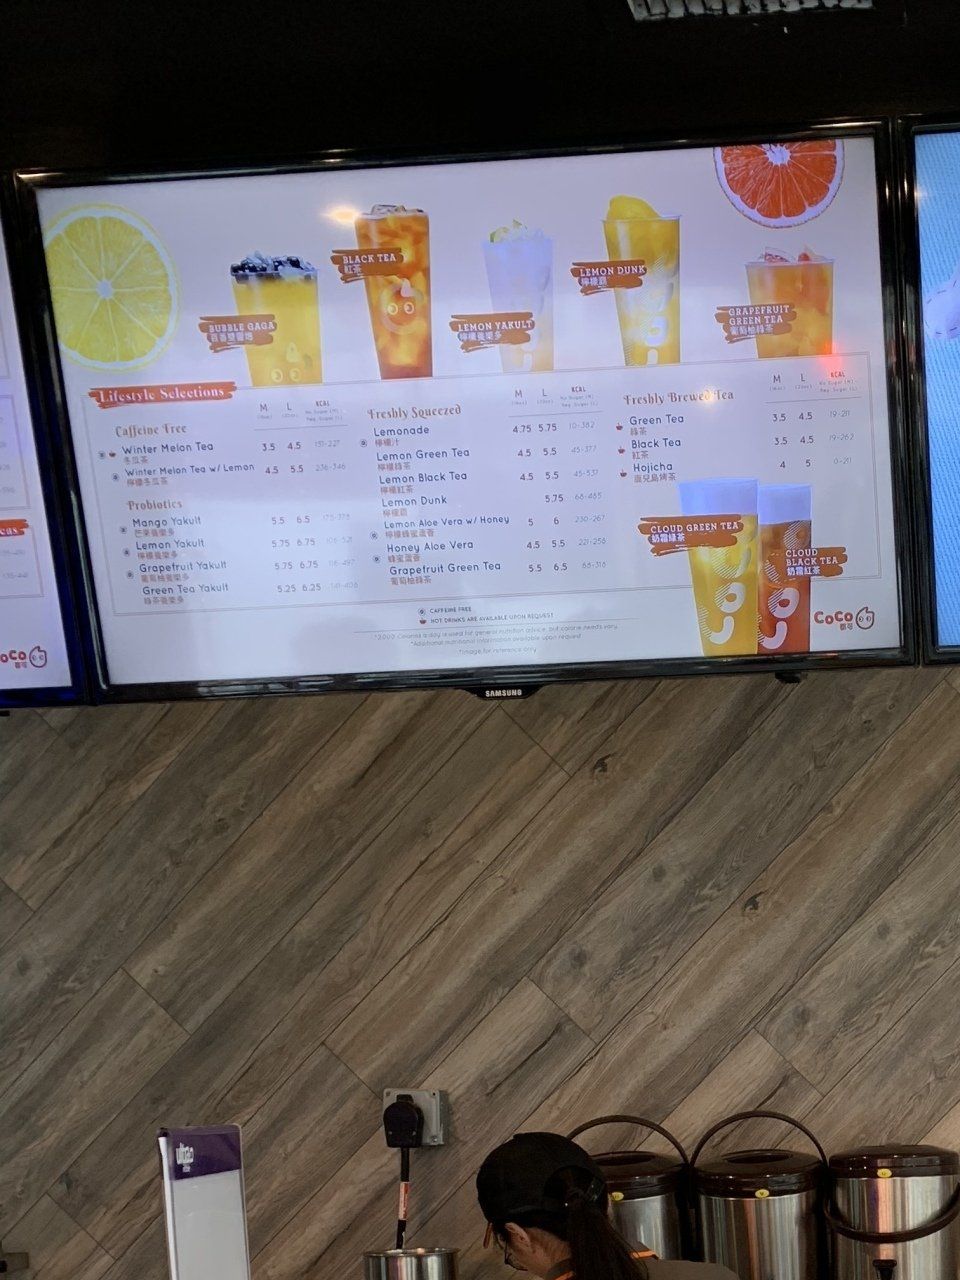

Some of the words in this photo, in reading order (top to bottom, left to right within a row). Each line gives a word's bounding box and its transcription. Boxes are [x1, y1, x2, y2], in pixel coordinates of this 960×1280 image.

[343, 255, 374, 263] BLACK
[378, 254, 396, 262] TEA
[580, 268, 614, 277] LEMON
[618, 266, 645, 275] DUNK
[729, 305, 789, 315] GRAPEFRUIT
[459, 322, 492, 331] LEMON
[495, 321, 532, 329] YAKULT
[729, 316, 761, 325] GREEN
[209, 323, 244, 332] BUBBLE
[247, 322, 275, 330] GAGA
[100, 389, 155, 402] Lifestyle
[160, 385, 224, 399] Selections
[624, 393, 664, 406] Freshly
[668, 391, 712, 403] Brewed
[714, 390, 733, 400] Tea
[368, 407, 408, 419] Freshly
[412, 405, 461, 418] Squeezed
[630, 416, 662, 425] Green
[666, 414, 684, 423] Tea
[772, 414, 786, 422] 3.5
[799, 412, 812, 420] 4.5
[116, 424, 158, 438] Caffeine
[163, 423, 187, 434] Free
[374, 426, 429, 437] Lemonade
[513, 425, 531, 433] 4.75
[539, 424, 557, 432] 5.75
[122, 444, 157, 455] Winter
[162, 443, 192, 453] Melon
[195, 442, 213, 451] Tea
[262, 443, 275, 451] 3.5
[287, 441, 301, 450] 4.5
[632, 439, 659, 448] Black
[663, 438, 681, 447] Tea
[775, 437, 787, 445] 3.5
[800, 436, 814, 444] 4.5
[377, 451, 412, 461] Lemon
[416, 450, 447, 459] Green
[452, 449, 470, 457] Tea
[518, 449, 531, 457] 4.5
[543, 448, 557, 456] 5.5
[125, 468, 157, 477] Winter
[159, 466, 186, 475] Melon
[189, 465, 206, 474] Tea
[210, 464, 220, 472] w/
[223, 463, 255, 471] Lemon
[265, 466, 279, 474] 4.5
[290, 464, 304, 473] 5.5
[633, 463, 673, 473] Hojicha
[379, 475, 414, 484] Lemon
[419, 473, 445, 481] Black
[449, 472, 467, 480] Tea
[520, 473, 533, 481] 4.5
[128, 500, 182, 510] Probiotics
[382, 498, 416, 507] Lemon
[421, 496, 447, 505] Dunk
[545, 494, 563, 503] 5.75
[133, 518, 168, 528] Mango
[171, 516, 201, 526] Yakult
[272, 516, 285, 525] 5.5
[297, 515, 310, 523] 6.5
[384, 520, 415, 529] Lemon
[419, 518, 438, 527] Aloe
[441, 517, 462, 526] Vera
[466, 517, 477, 525] w/
[480, 515, 510, 525] Honey
[651, 525, 683, 533] CLOUD
[687, 523, 717, 532] GREEN
[720, 522, 739, 530] TEA
[136, 541, 171, 550] Lemon
[174, 539, 205, 548] Yakult
[272, 539, 290, 548] 5.75
[297, 538, 315, 546] 6.75
[387, 544, 419, 554] Honey
[424, 542, 446, 551] Aloe
[450, 540, 473, 549] Vera
[527, 541, 540, 549] 4.5
[786, 549, 818, 557] CLOUD
[786, 558, 817, 566] BLACK
[821, 556, 838, 564] TEA
[140, 562, 193, 574] Grapefruit
[197, 561, 227, 570] Yakult
[275, 562, 293, 570] 5.75
[390, 564, 444, 576] Grapefruit
[448, 563, 479, 572] Green
[483, 562, 501, 570] Tea
[529, 564, 542, 572] 5.5
[554, 563, 567, 571] 6.5
[143, 586, 174, 595] Green
[177, 585, 195, 593] Tea
[199, 584, 229, 593] Yakult
[278, 585, 296, 593] 5.25
[814, 610, 853, 625] CoCo
[485, 689, 522, 697] SAMSUNG
